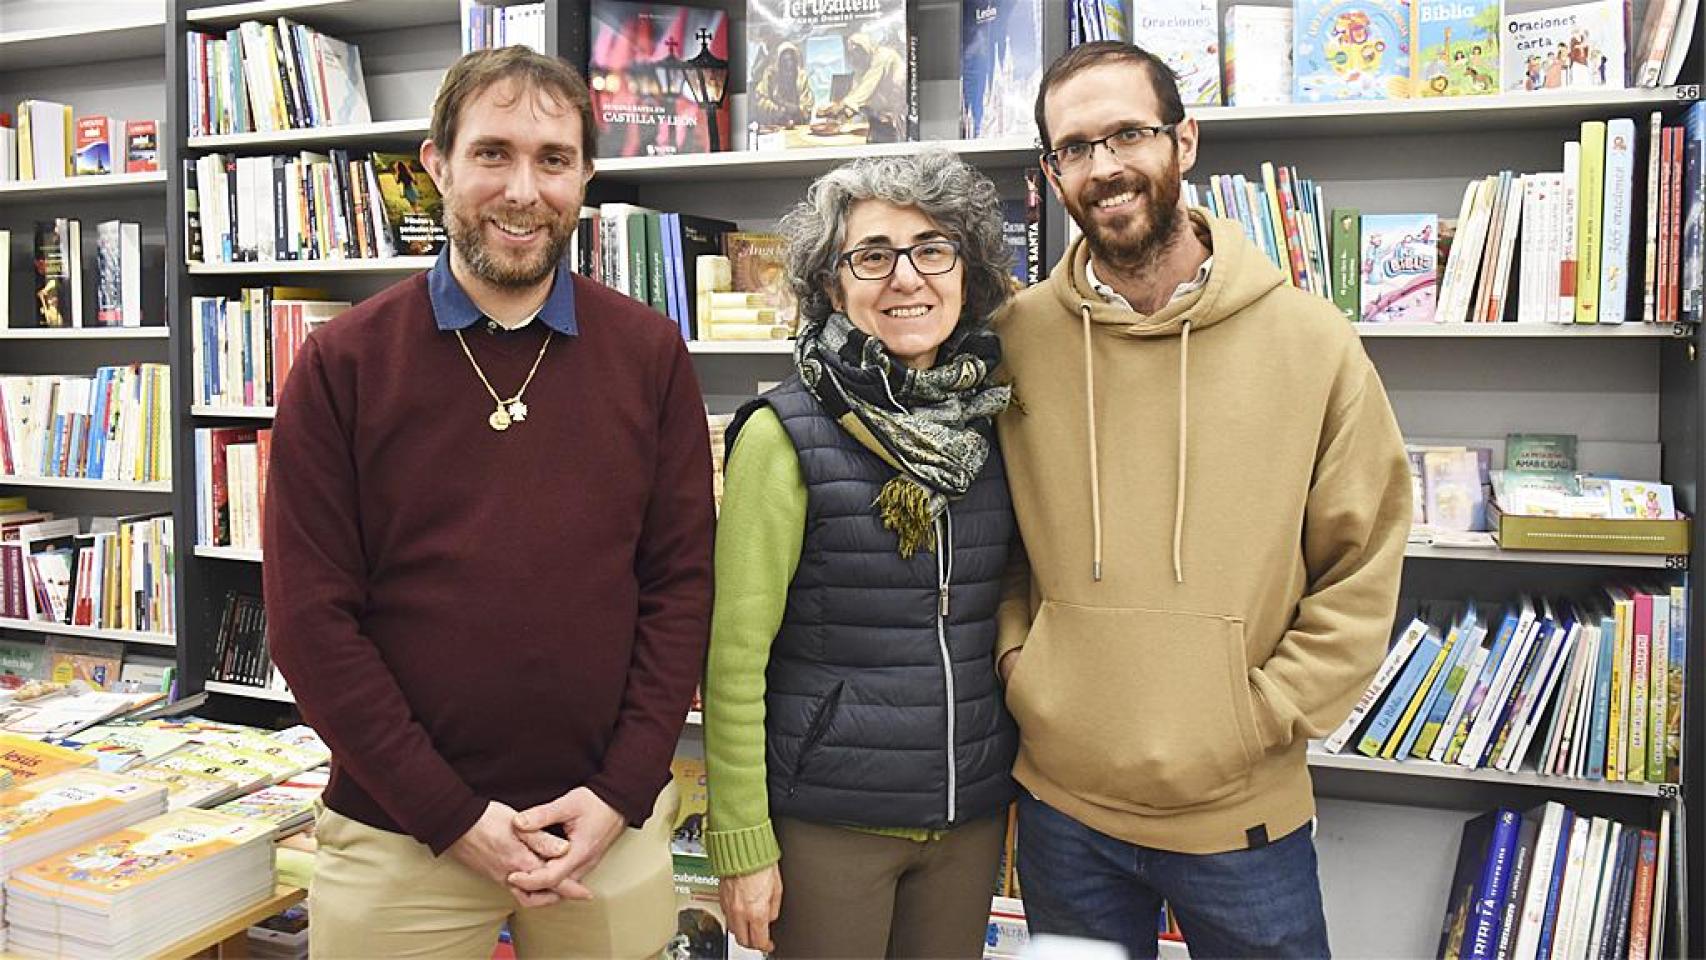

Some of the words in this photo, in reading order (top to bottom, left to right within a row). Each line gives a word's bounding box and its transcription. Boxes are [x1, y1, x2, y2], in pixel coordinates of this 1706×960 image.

[975, 4, 997, 20] León
[1508, 14, 1577, 34] Oraciones
[1516, 37, 1554, 51] carta
[1676, 86, 1698, 99] 56
[603, 111, 656, 125] CASTILLA
[657, 114, 666, 125] Y
[1673, 322, 1692, 337] 57
[1515, 459, 1570, 470] AMABILIDAD
[1665, 554, 1685, 568] 58
[1657, 784, 1679, 798] 59
